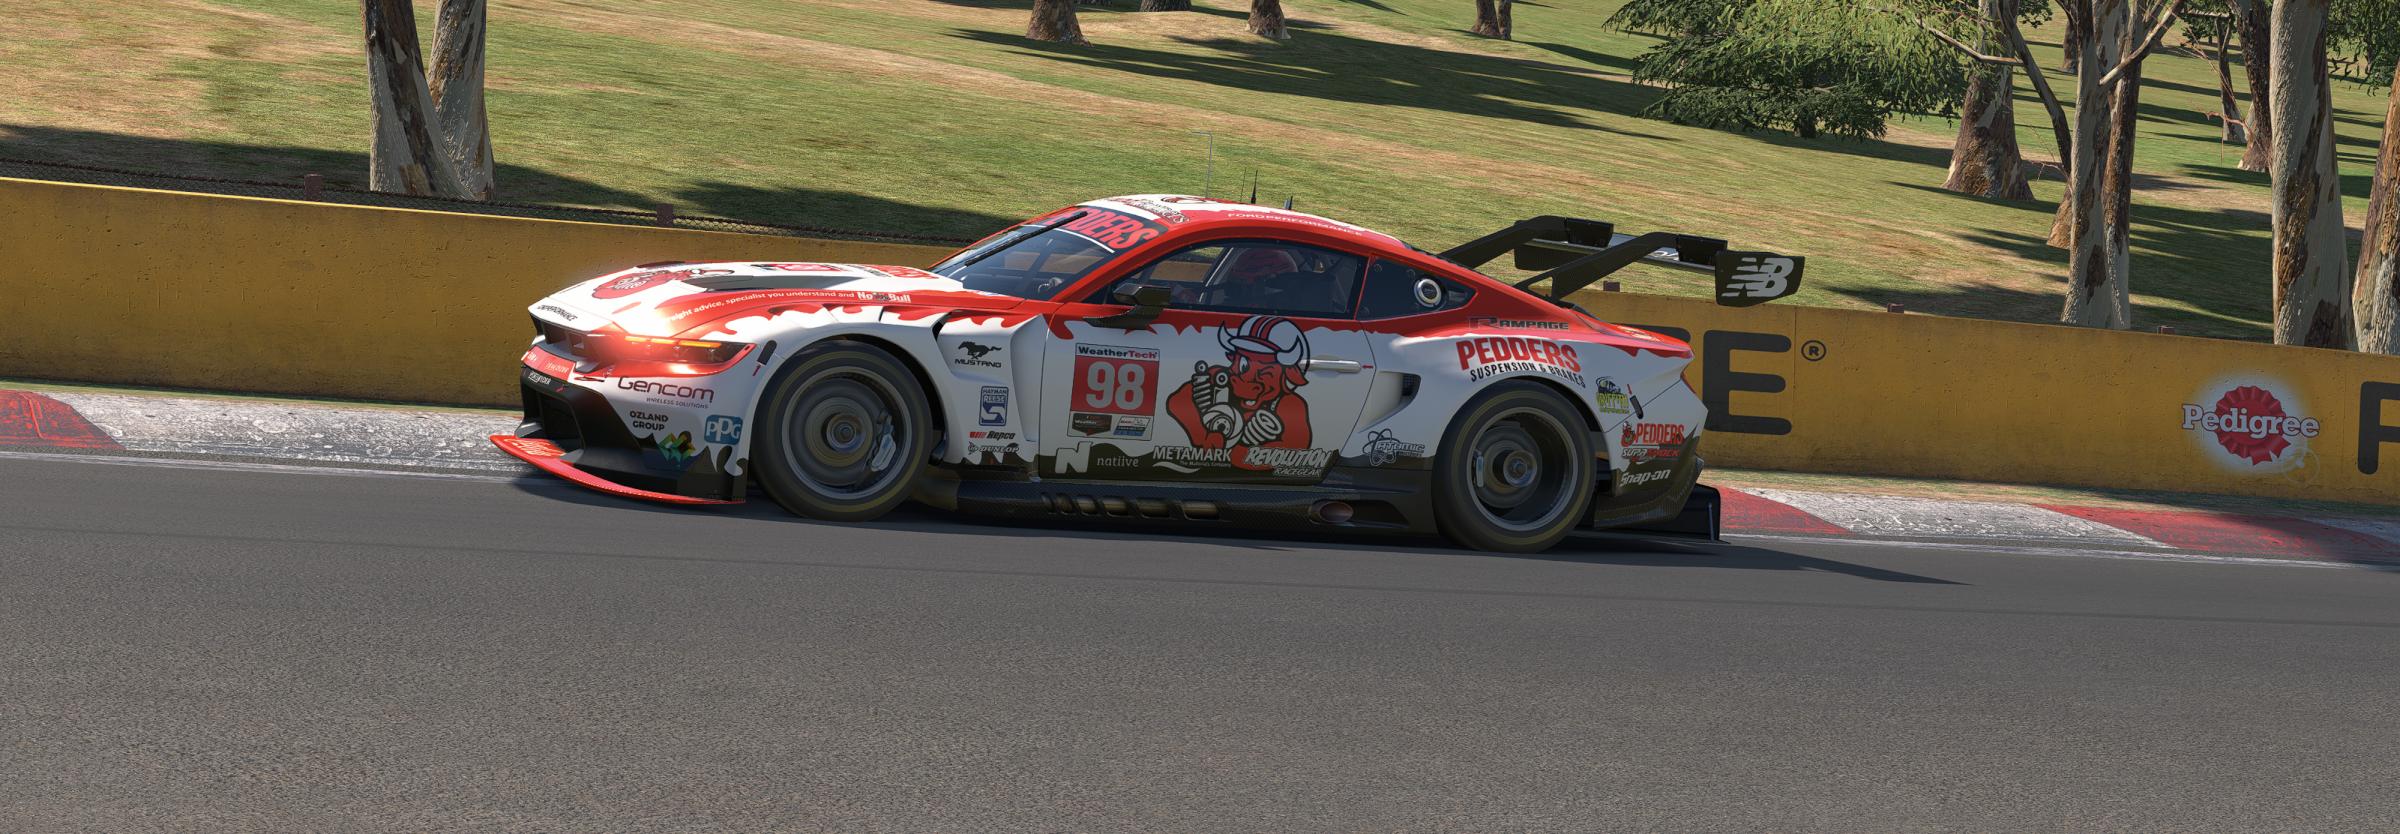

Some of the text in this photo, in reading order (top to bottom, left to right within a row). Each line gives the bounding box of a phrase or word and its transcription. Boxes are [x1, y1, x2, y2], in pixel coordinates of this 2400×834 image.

[694, 301, 725, 312] advice,
[726, 292, 766, 304] specialist
[786, 290, 836, 298] understand
[857, 291, 873, 301] No
[888, 293, 911, 303] Bull
[1469, 317, 1569, 330] RAMPAGE
[1078, 346, 1157, 359] WeatherTech
[1456, 337, 1582, 373] PEDDERS
[955, 358, 1002, 368] MUSTANG
[1470, 362, 1537, 382] SUSPENSION
[1548, 365, 1586, 389] BRAKES
[618, 375, 715, 403] Gencom
[1086, 361, 1145, 410] 98
[675, 401, 709, 409] SOLUTIONS
[629, 410, 669, 423] OZLAND
[2181, 404, 2320, 439] Pedigree
[632, 420, 665, 432] GROUP
[705, 417, 742, 442] PPG
[1635, 423, 1685, 444] PEDDERS
[986, 430, 1016, 440] Repco
[980, 445, 1020, 453] DUNLOP
[1152, 446, 1232, 462] METAMARK
[1244, 446, 1332, 468] REVOLUTION
[1274, 467, 1321, 477] RACEGEAR
[1619, 469, 1672, 487] Snap-on
